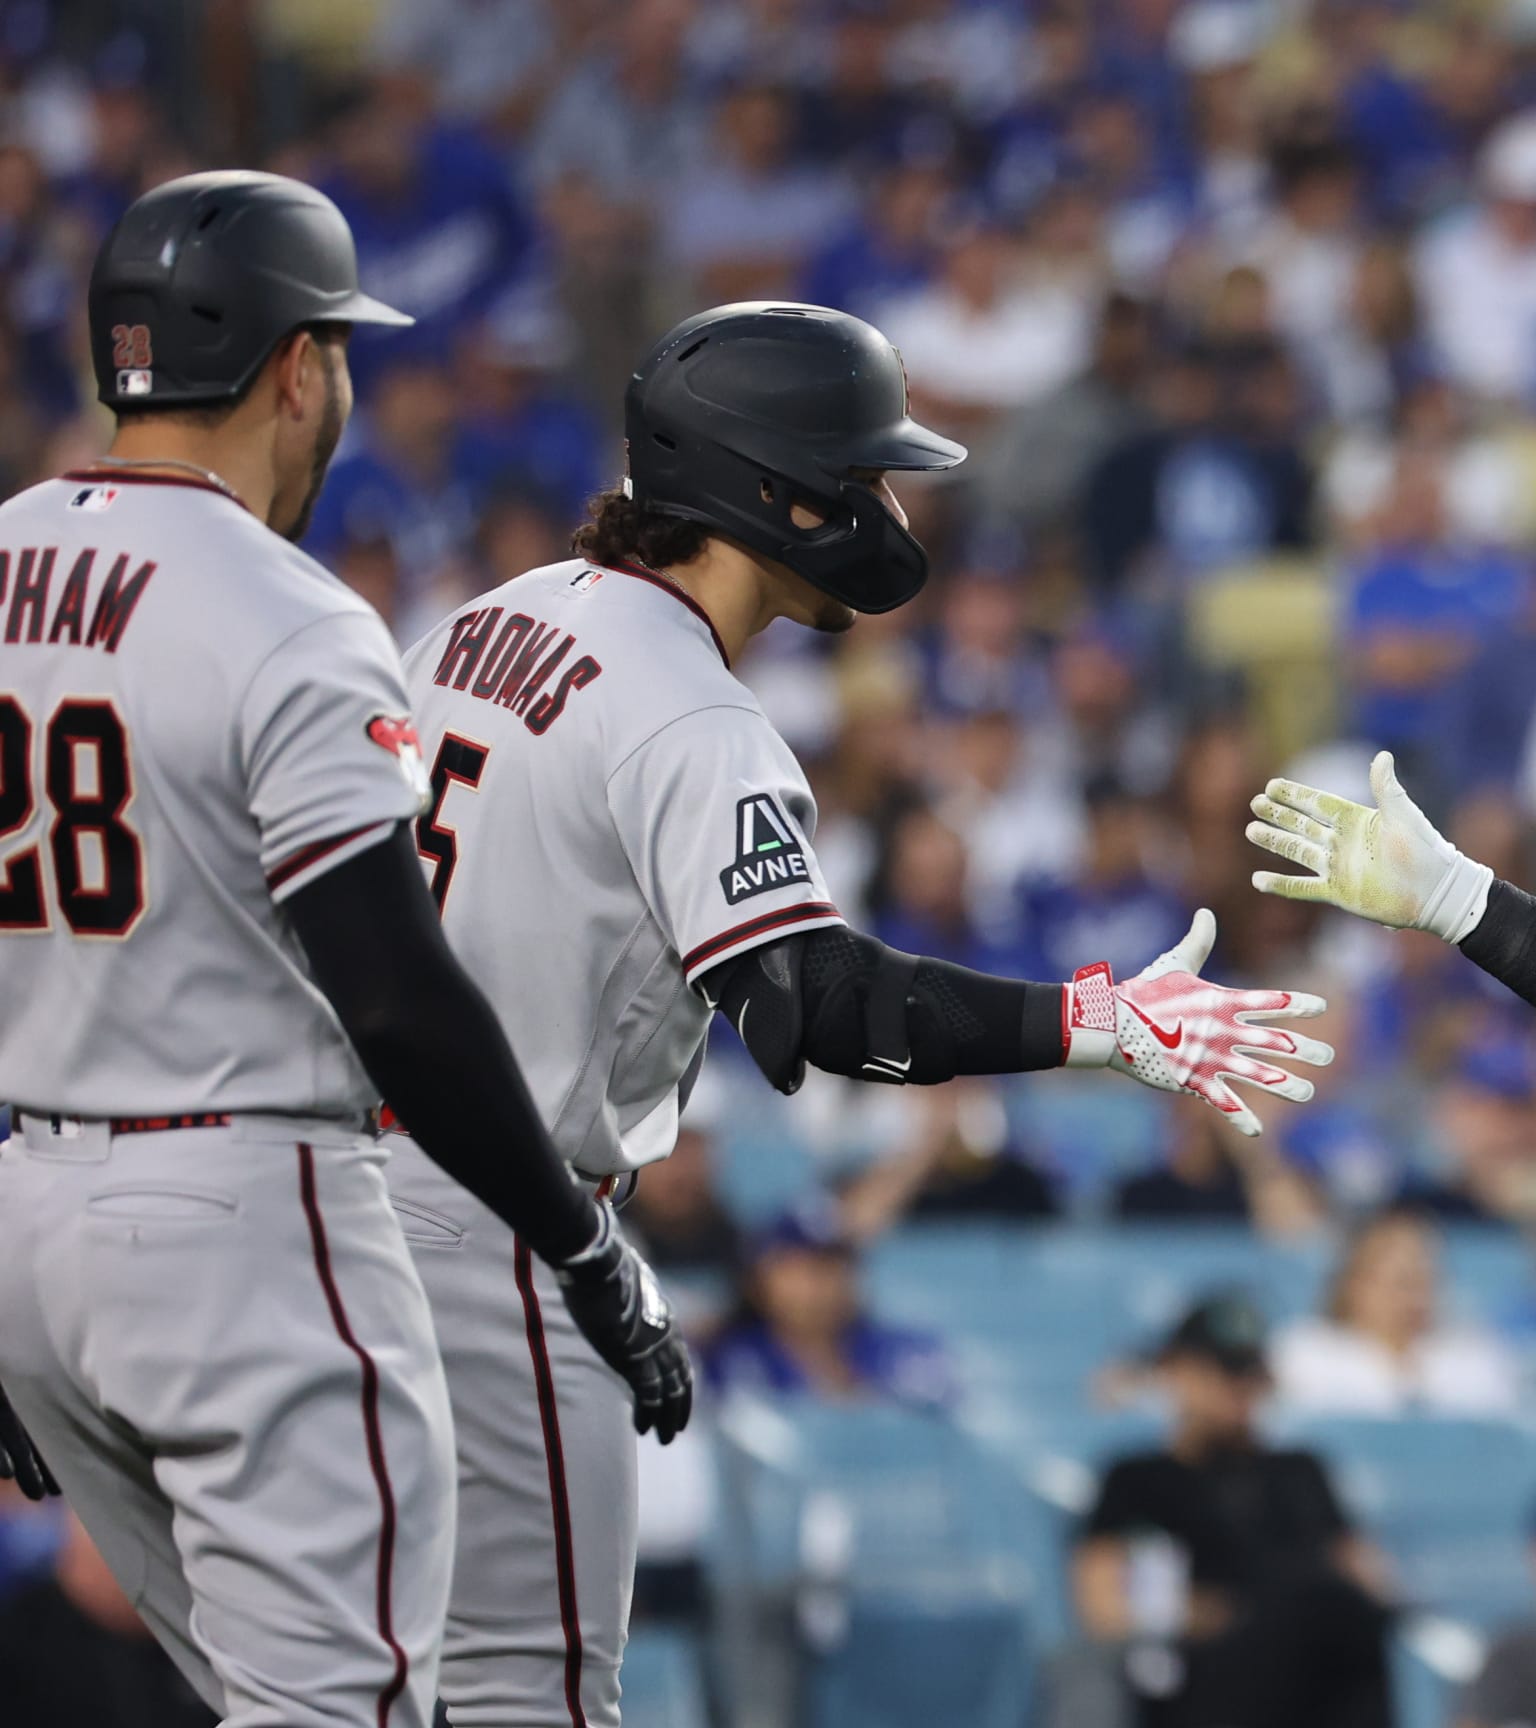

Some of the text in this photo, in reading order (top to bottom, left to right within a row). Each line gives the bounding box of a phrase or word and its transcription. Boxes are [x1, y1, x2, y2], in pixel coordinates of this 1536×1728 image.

[111, 324, 152, 368] 28
[0, 547, 157, 654] HAM
[432, 606, 603, 736] THOMAS
[731, 854, 808, 896] AVNE
